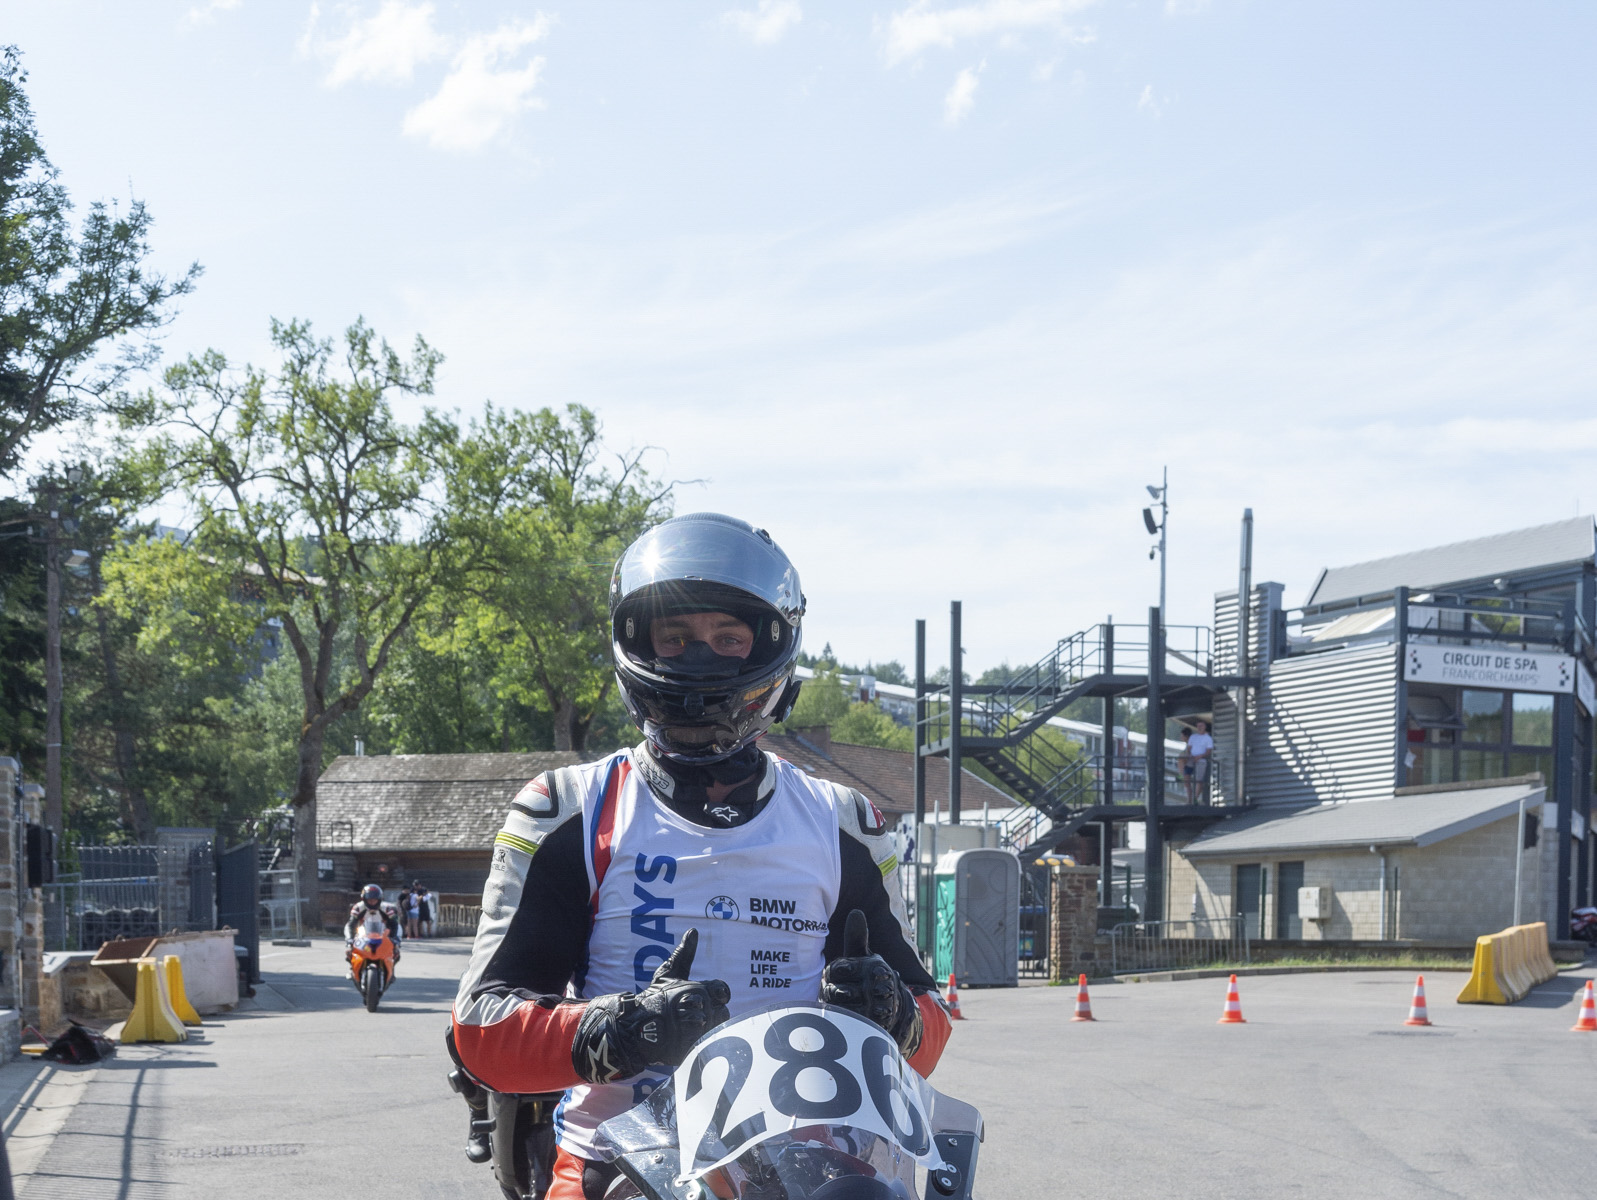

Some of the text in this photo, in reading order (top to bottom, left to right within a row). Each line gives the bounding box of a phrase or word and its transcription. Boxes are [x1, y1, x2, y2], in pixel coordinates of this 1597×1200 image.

[1443, 652, 1538, 671] CIRCUIT DE SPA
[1442, 667, 1538, 685] FRANCORCHAMPS
[750, 897, 796, 914] BMW
[631, 852, 678, 982] DAYS
[750, 949, 790, 962] MAKE
[750, 963, 777, 975] LIFE
[749, 977, 792, 988] A RIDE
[685, 1012, 930, 1170] 286
